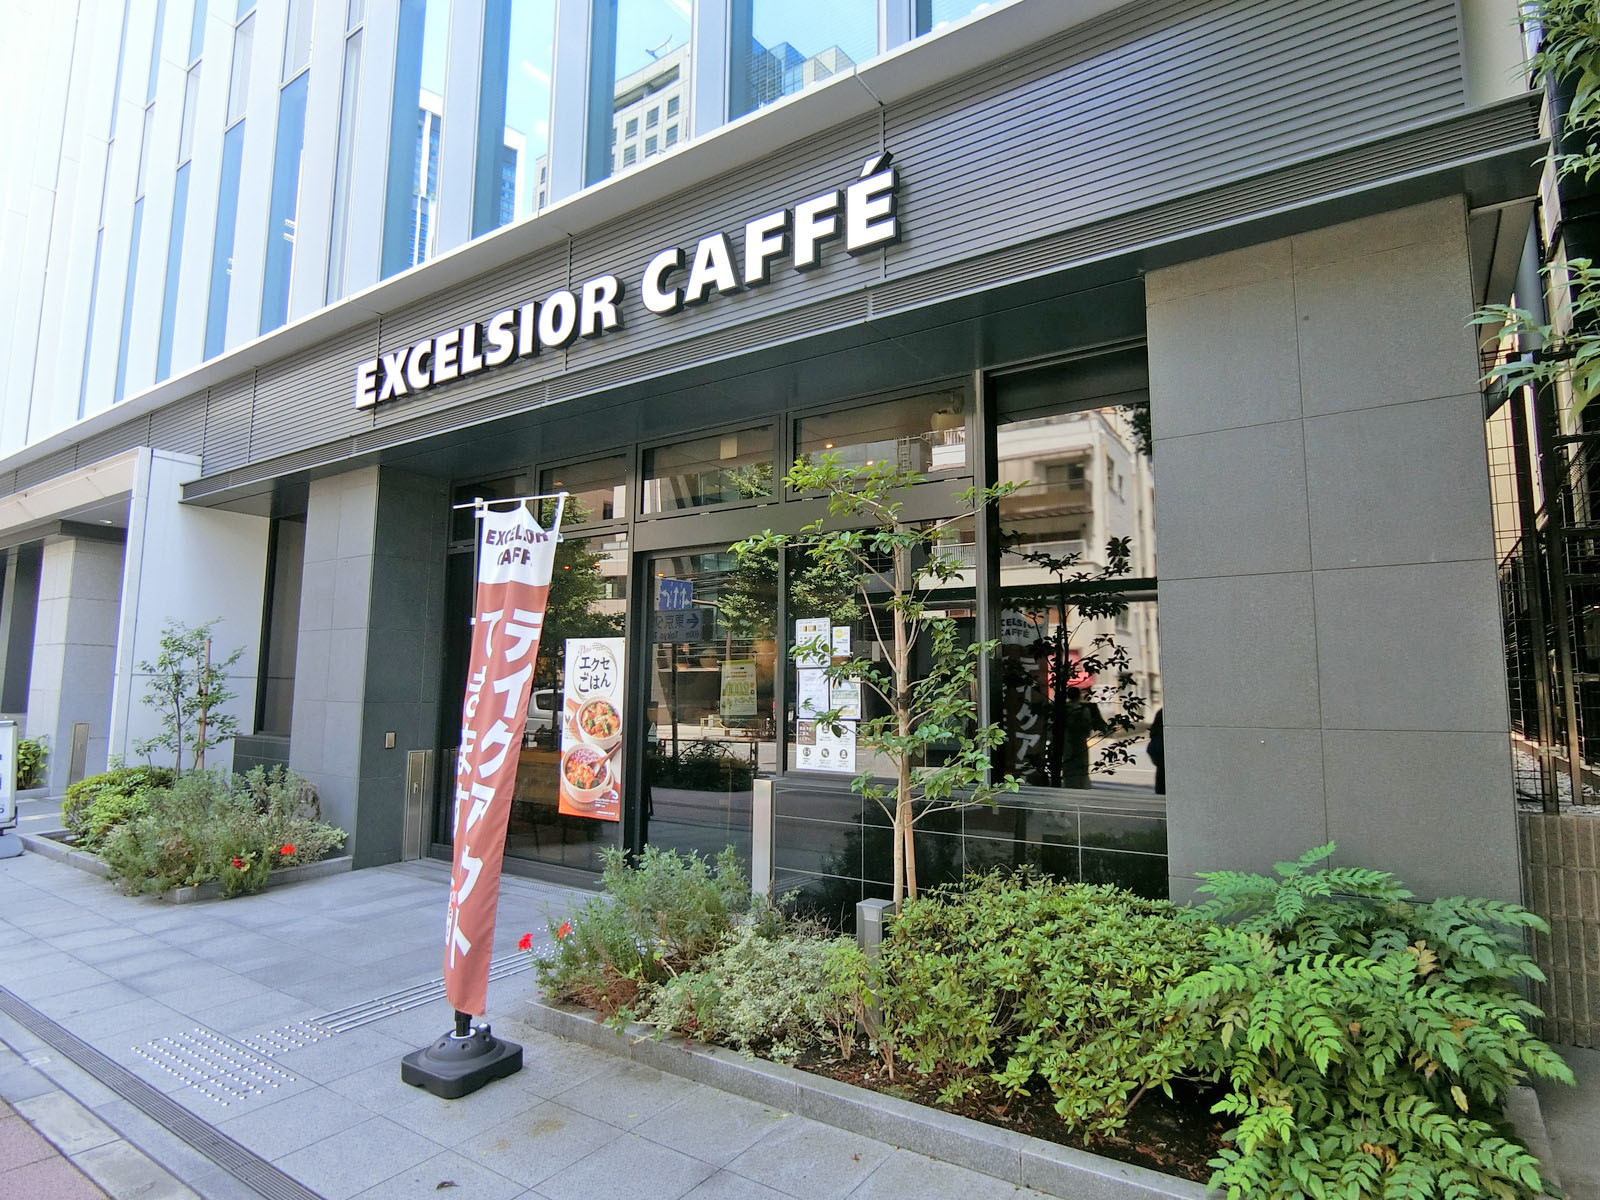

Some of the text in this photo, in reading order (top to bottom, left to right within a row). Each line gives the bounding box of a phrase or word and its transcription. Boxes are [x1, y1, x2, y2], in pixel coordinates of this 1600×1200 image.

[356, 151, 898, 410] EXCELSIOR CAFFÉ
[579, 656, 611, 672] エクセ
[578, 672, 611, 692] ごはん
